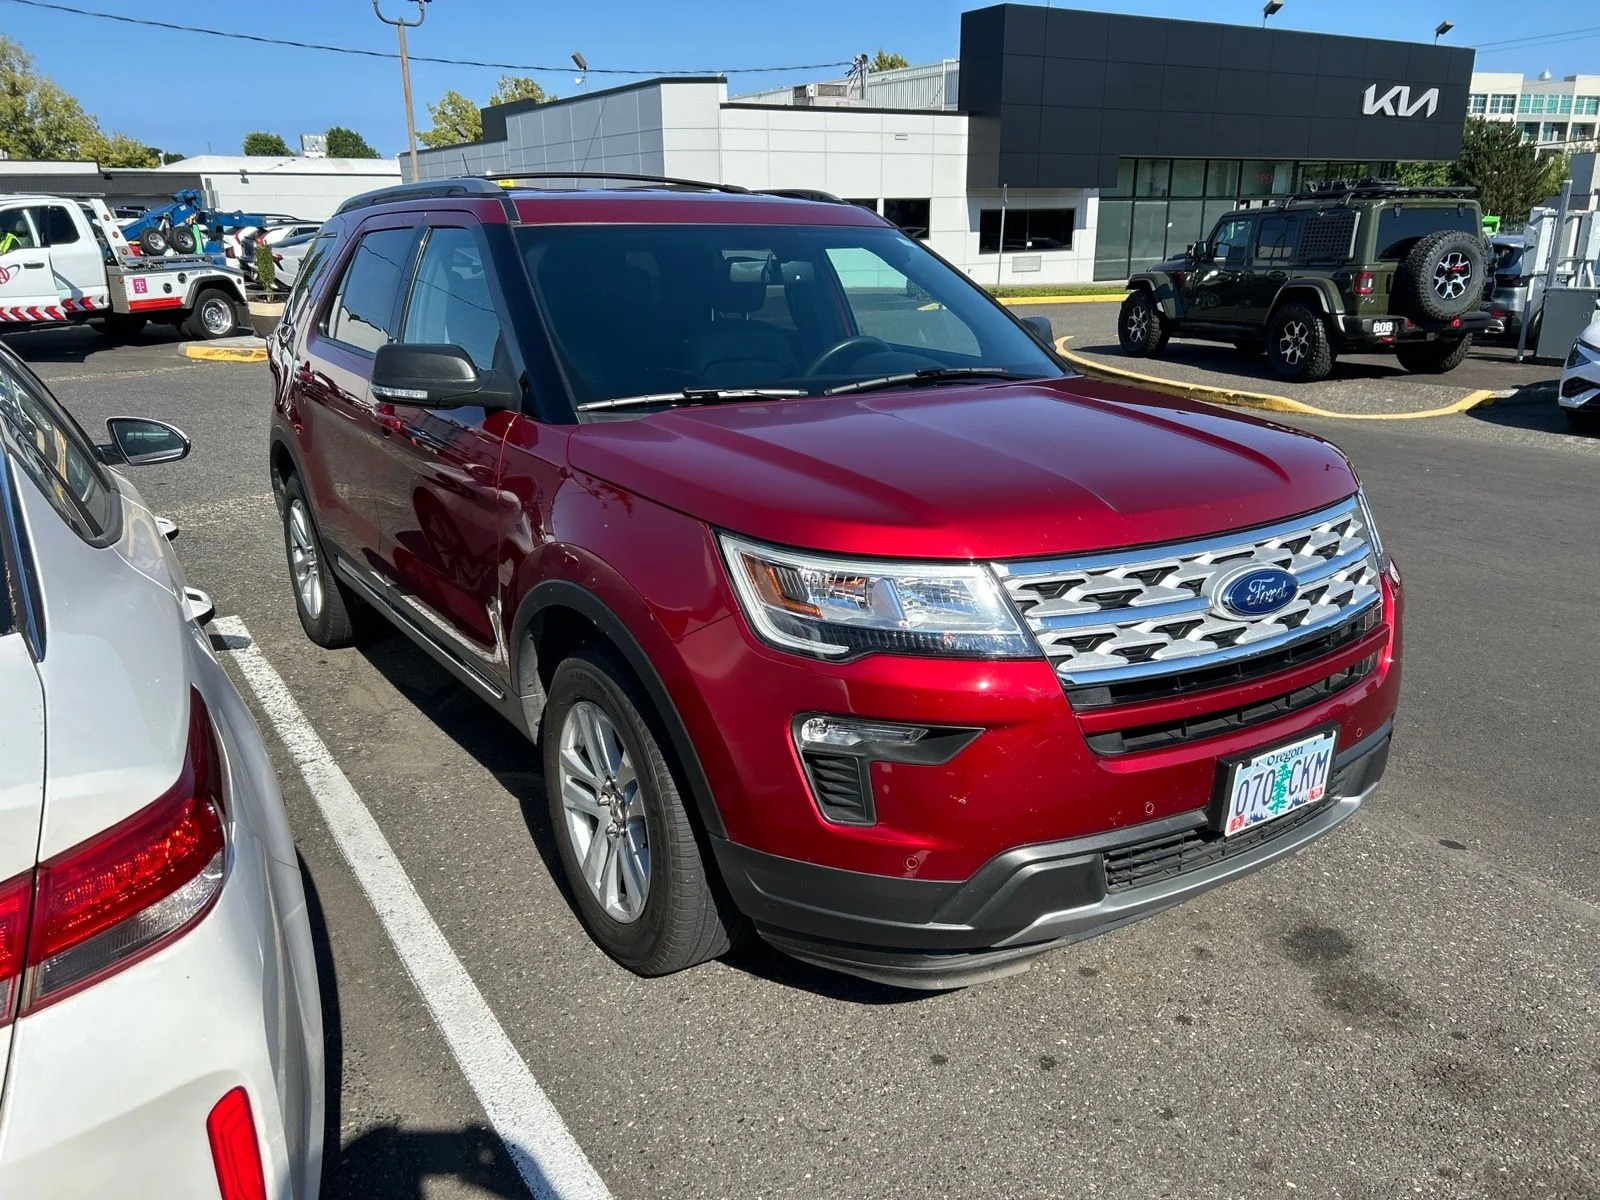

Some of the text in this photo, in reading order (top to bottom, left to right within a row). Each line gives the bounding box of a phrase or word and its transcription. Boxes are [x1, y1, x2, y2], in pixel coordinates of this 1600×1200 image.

[1362, 84, 1439, 118] KIA
[1373, 321, 1393, 333] BOB
[1246, 577, 1288, 605] Ford
[1267, 746, 1304, 766] Oregon
[1235, 749, 1330, 816] 070 CKM
